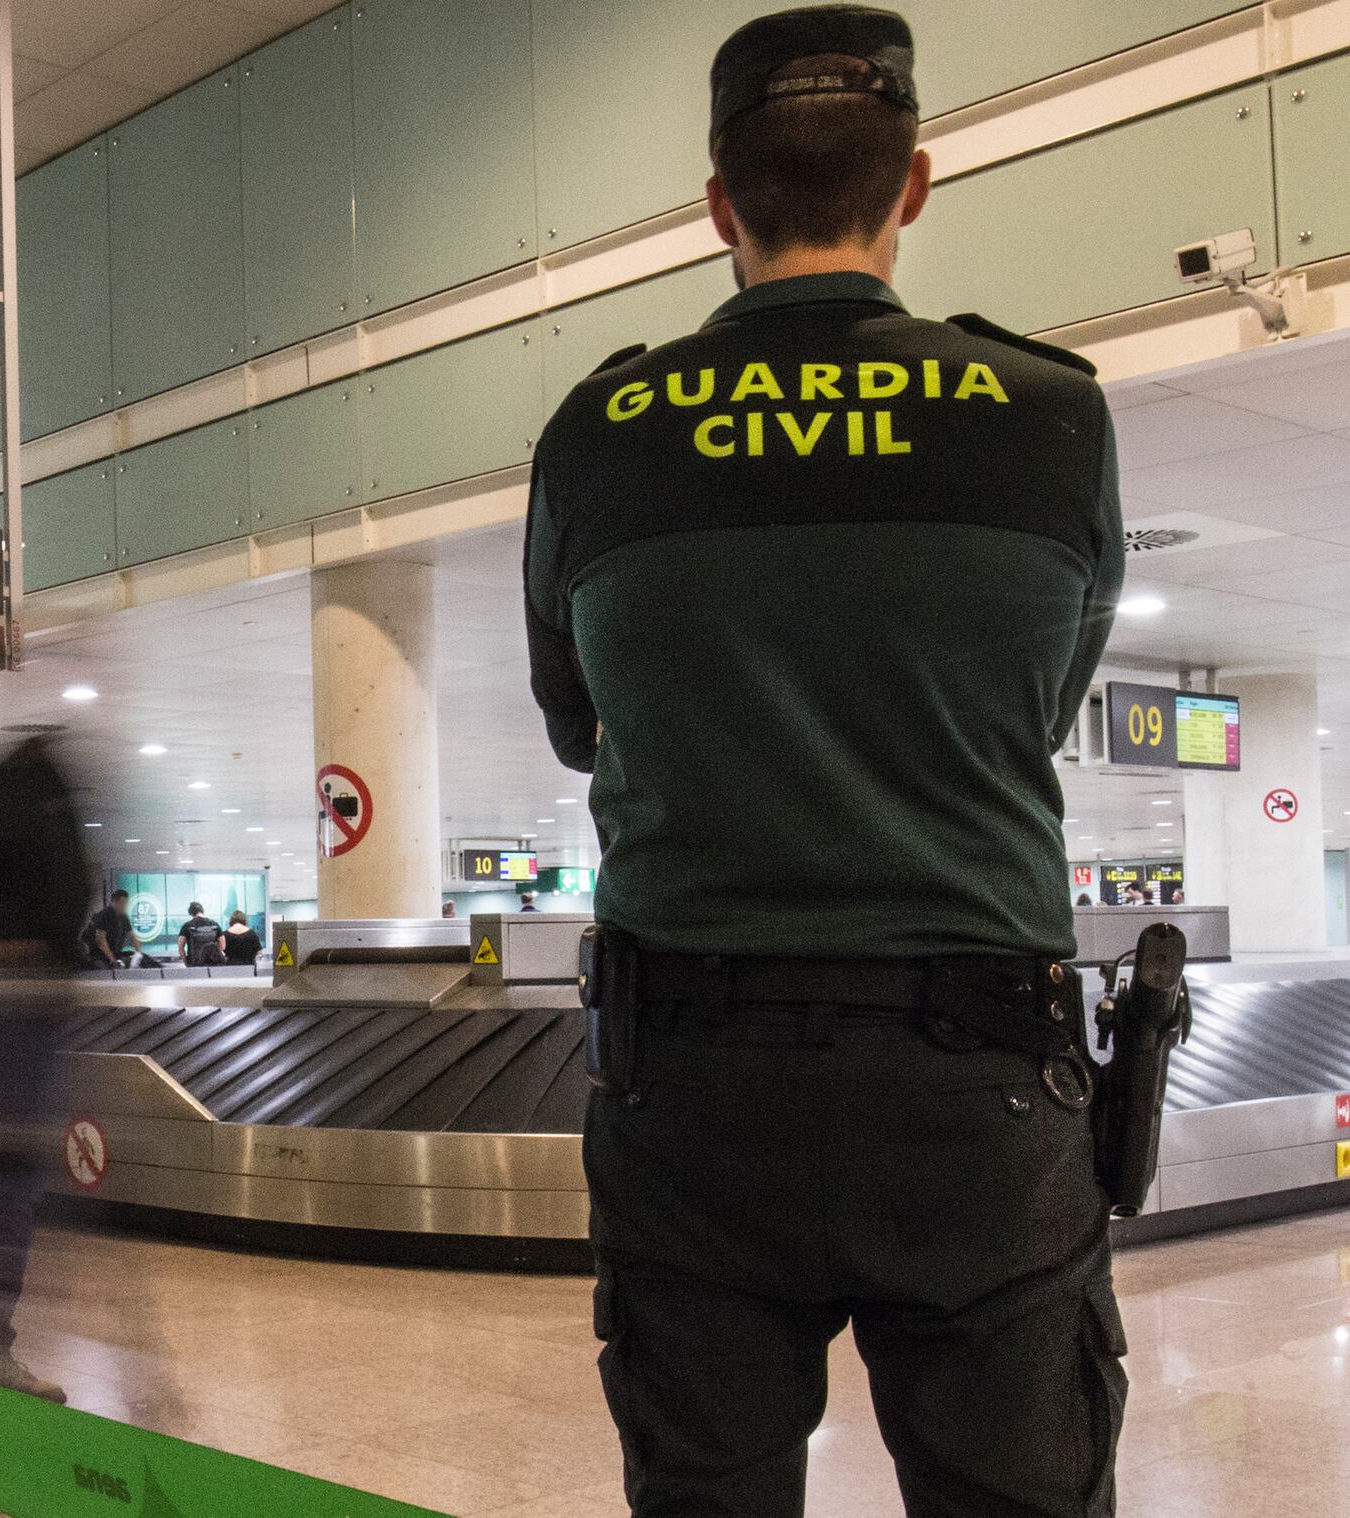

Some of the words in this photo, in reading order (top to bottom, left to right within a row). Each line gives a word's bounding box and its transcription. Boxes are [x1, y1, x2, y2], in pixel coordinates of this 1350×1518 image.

[606, 359, 1010, 422] GUARDIA
[693, 411, 912, 458] CIVIL
[1128, 703, 1163, 746] 09
[475, 857, 492, 875] 10
